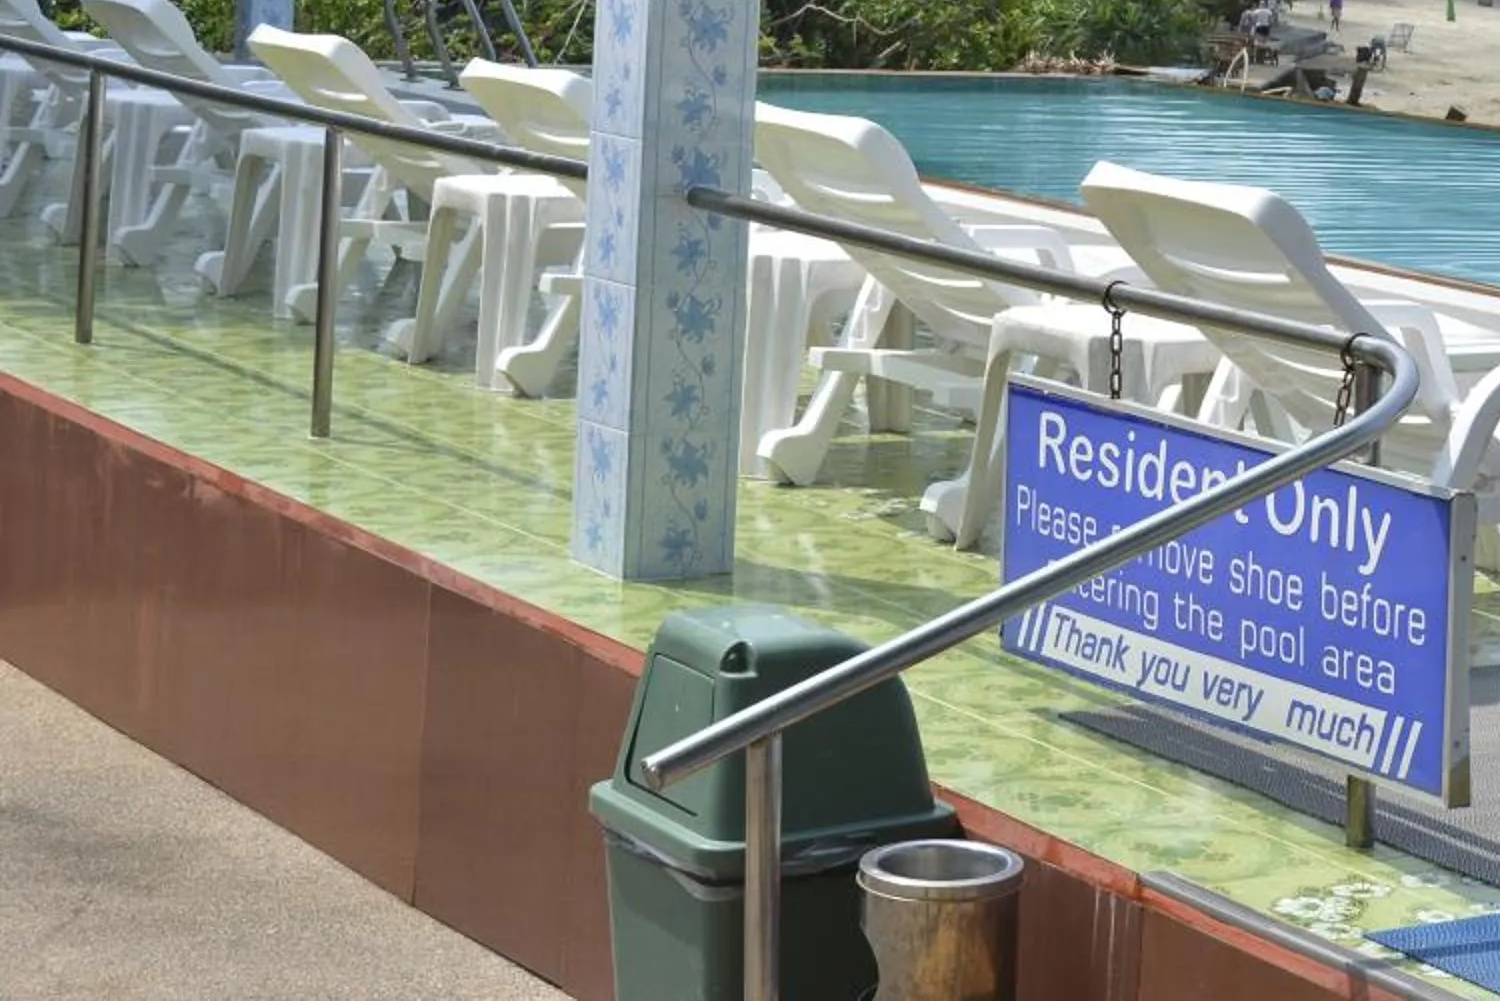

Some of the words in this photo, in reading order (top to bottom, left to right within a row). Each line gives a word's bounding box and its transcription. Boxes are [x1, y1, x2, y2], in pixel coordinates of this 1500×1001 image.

[1017, 486, 1097, 547] Please
[1112, 524, 1214, 584] ove
[1229, 550, 1304, 611] shoe
[1321, 571, 1426, 646] before
[1266, 480, 1391, 576] Only
[1047, 560, 1159, 631] ering
[1173, 591, 1224, 640] the
[1240, 618, 1305, 667] pool
[1322, 645, 1396, 695] area
[1053, 611, 1129, 673] Thank
[1137, 647, 1190, 692] you
[1202, 670, 1264, 721] very
[1285, 698, 1376, 754] much
